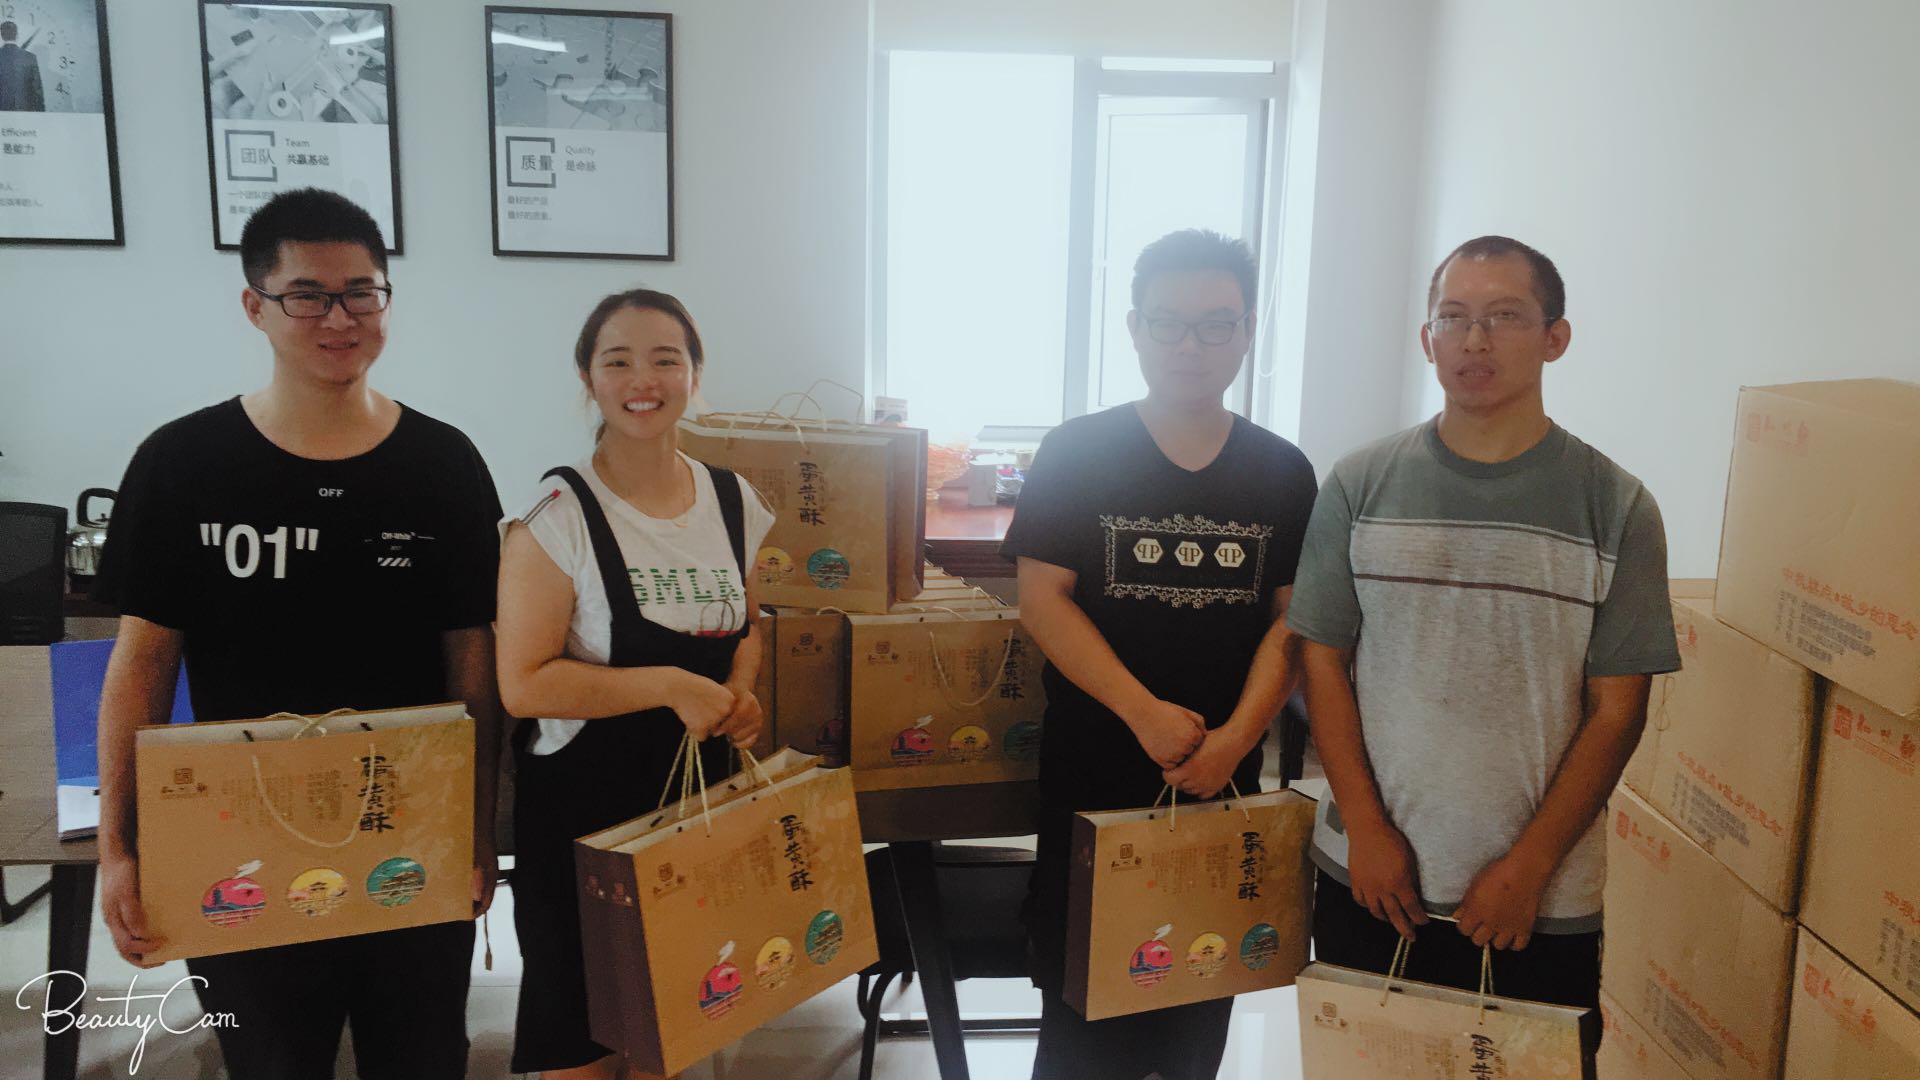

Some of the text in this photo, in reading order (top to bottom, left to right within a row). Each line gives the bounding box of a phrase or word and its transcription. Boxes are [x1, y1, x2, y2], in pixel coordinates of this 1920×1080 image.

[1, 127, 38, 137] Efficient
[285, 138, 311, 148] Team
[241, 147, 276, 165] 团队
[565, 145, 596, 156] Quality
[287, 153, 330, 166] 共赢基础
[521, 154, 554, 171] 质量
[318, 487, 345, 498] OFF
